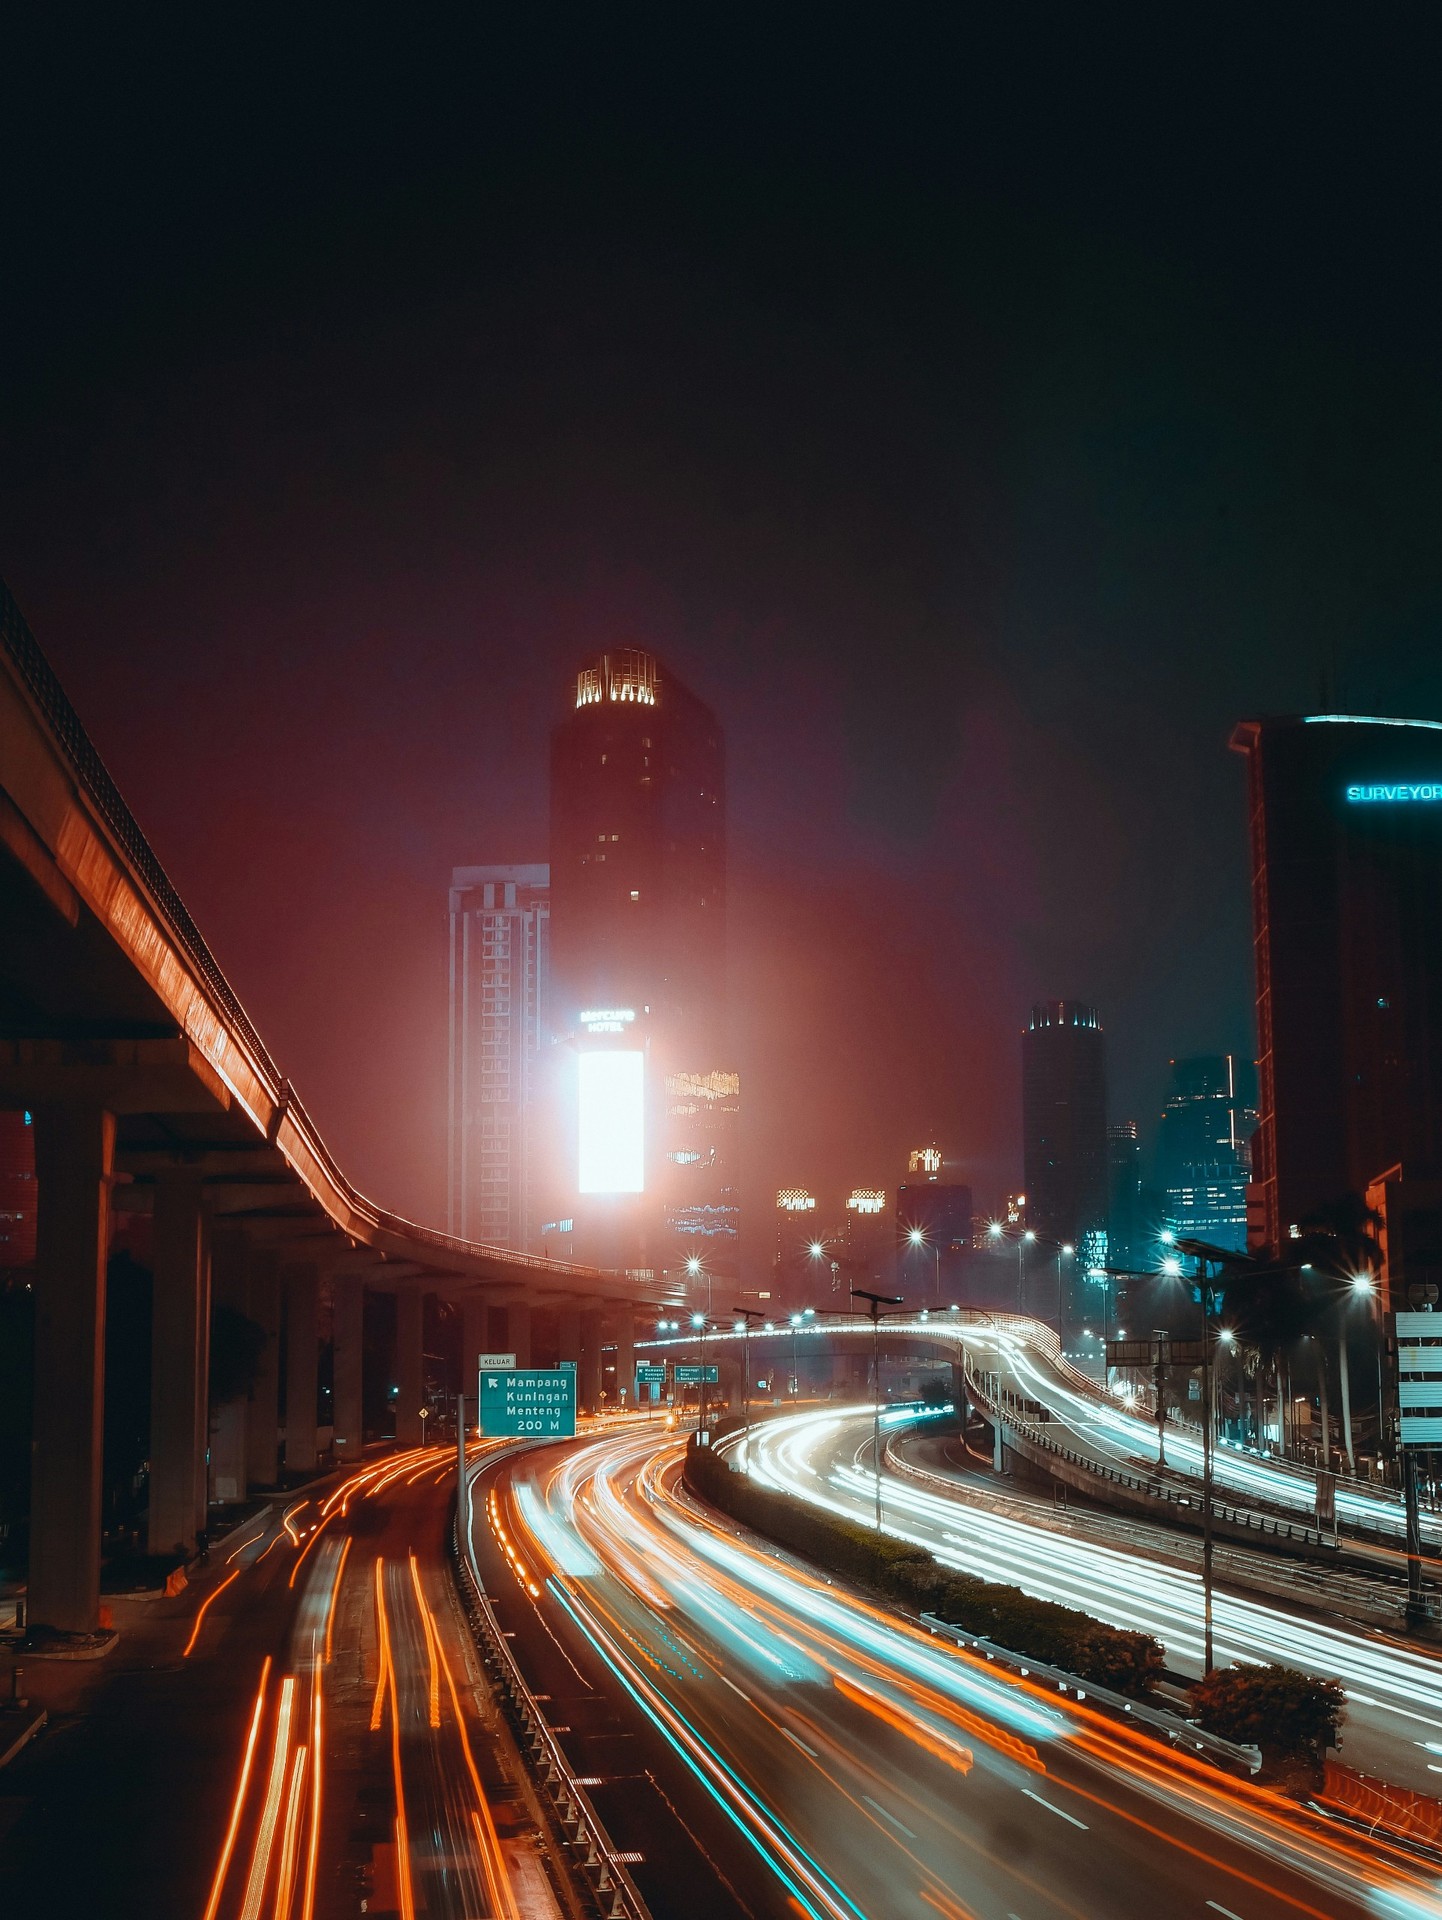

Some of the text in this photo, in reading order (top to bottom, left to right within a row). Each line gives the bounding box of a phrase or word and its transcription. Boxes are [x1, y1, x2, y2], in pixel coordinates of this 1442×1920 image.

[484, 1358, 511, 1366] KELUAR
[506, 1377, 568, 1390] Mampang
[506, 1391, 569, 1404] Kuningan
[506, 1406, 562, 1418] Menteng
[517, 1420, 559, 1431] 200 M
